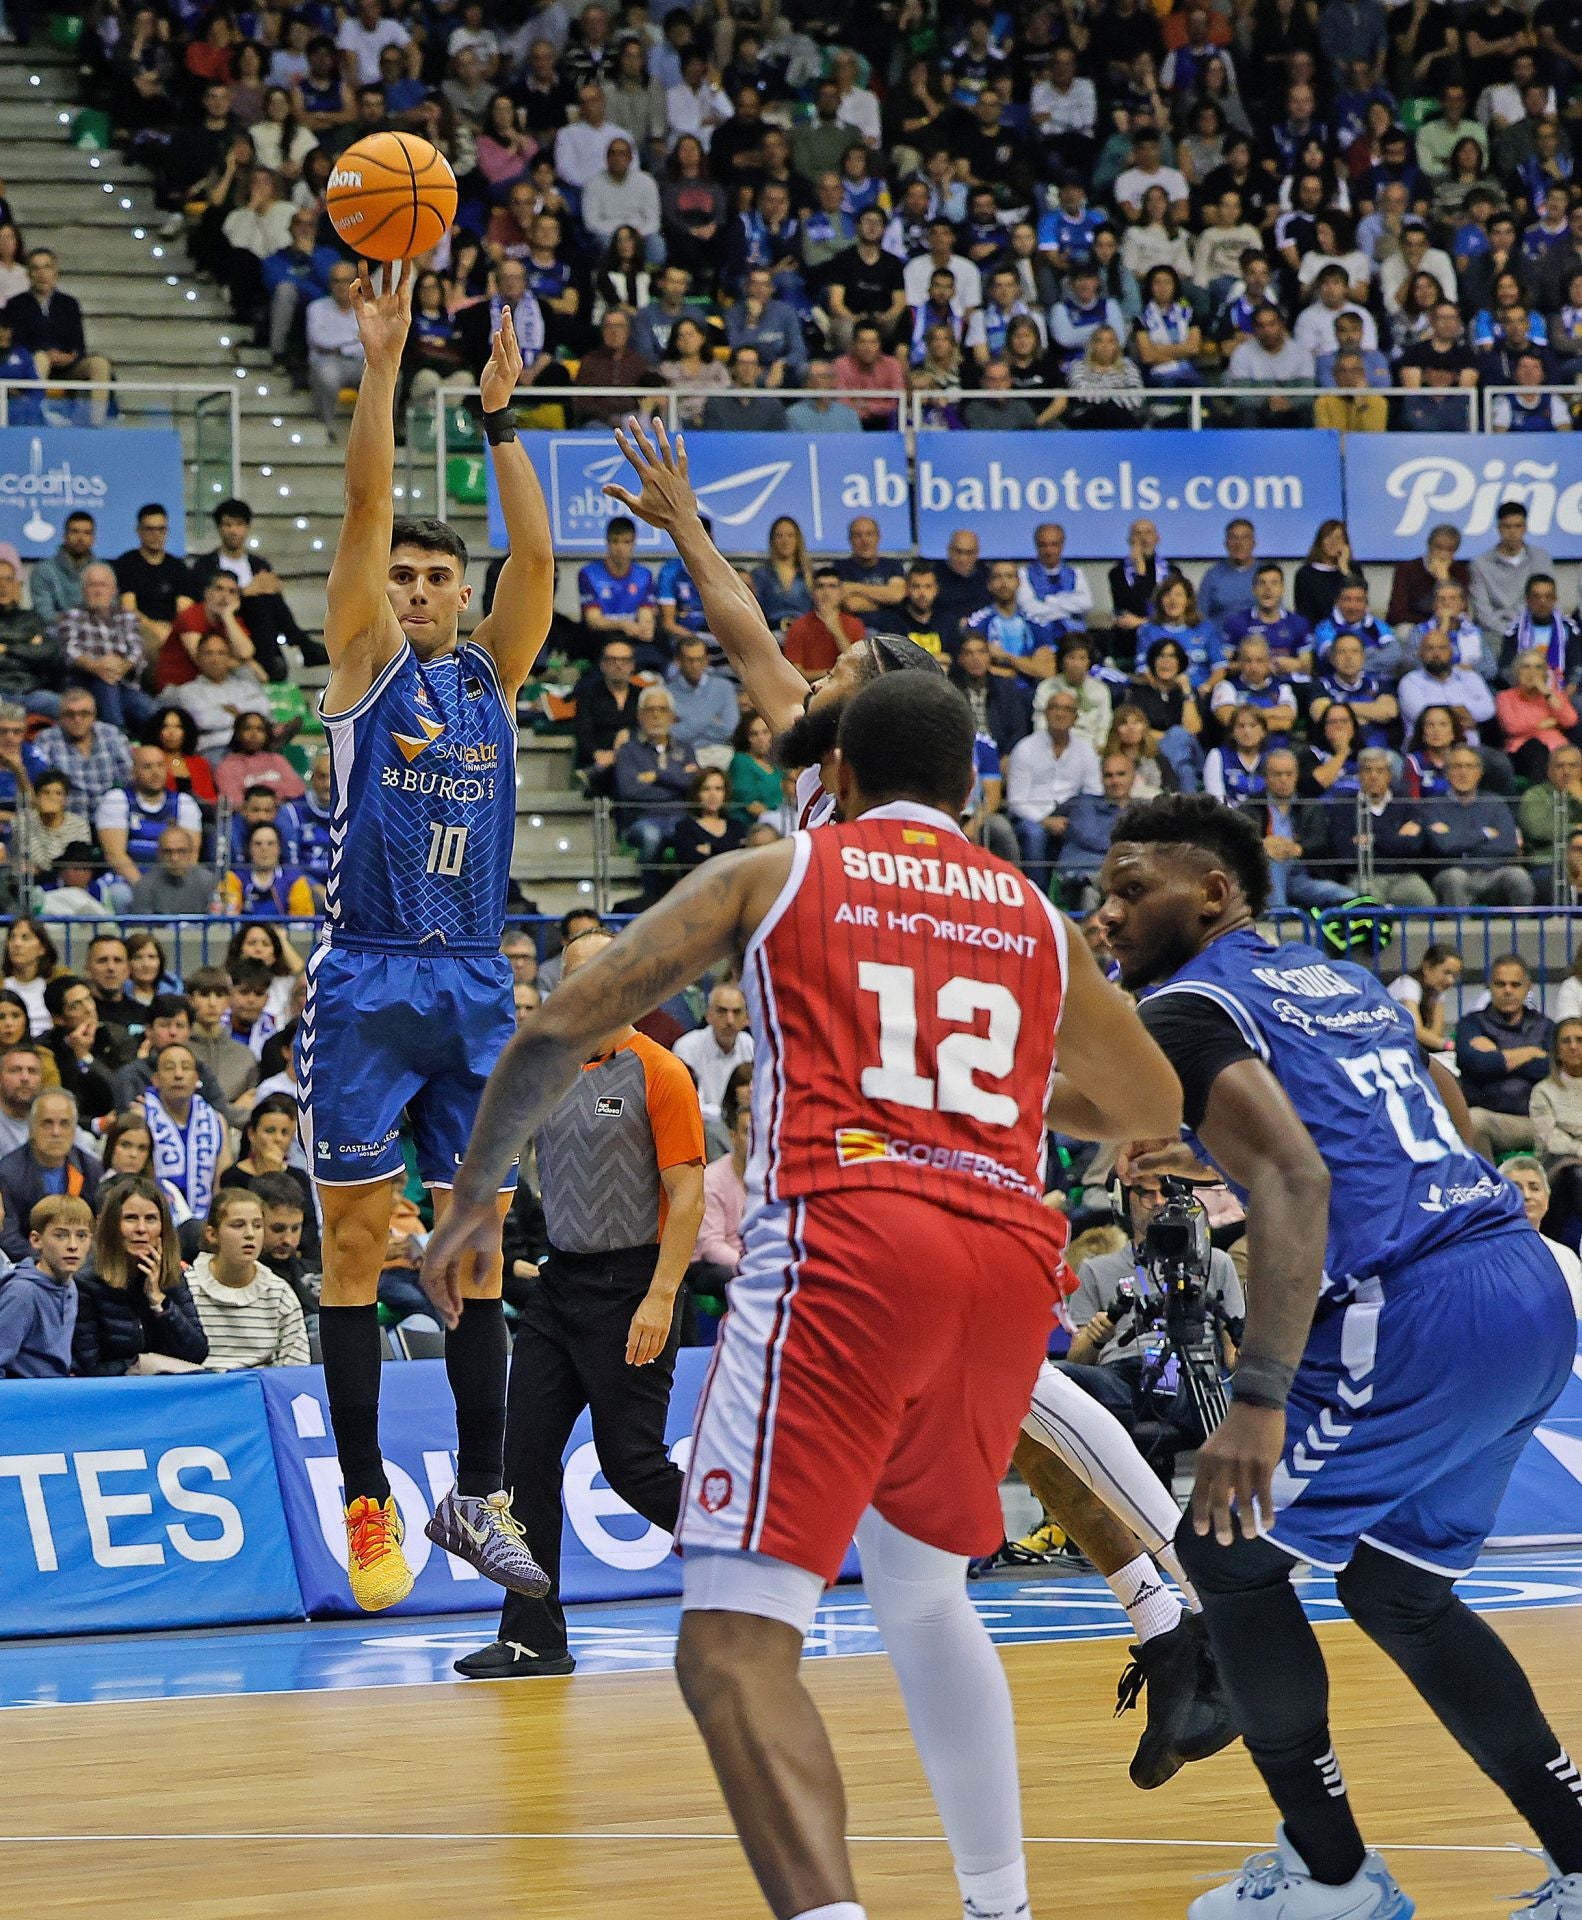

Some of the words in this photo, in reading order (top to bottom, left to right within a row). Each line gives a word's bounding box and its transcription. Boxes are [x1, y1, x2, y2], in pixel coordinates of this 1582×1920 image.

[426, 821, 468, 877] 10
[840, 846, 1025, 908] SORIANO
[834, 902, 880, 928] AIR
[887, 910, 1038, 958] HORIZONT
[857, 960, 1022, 1129] 12
